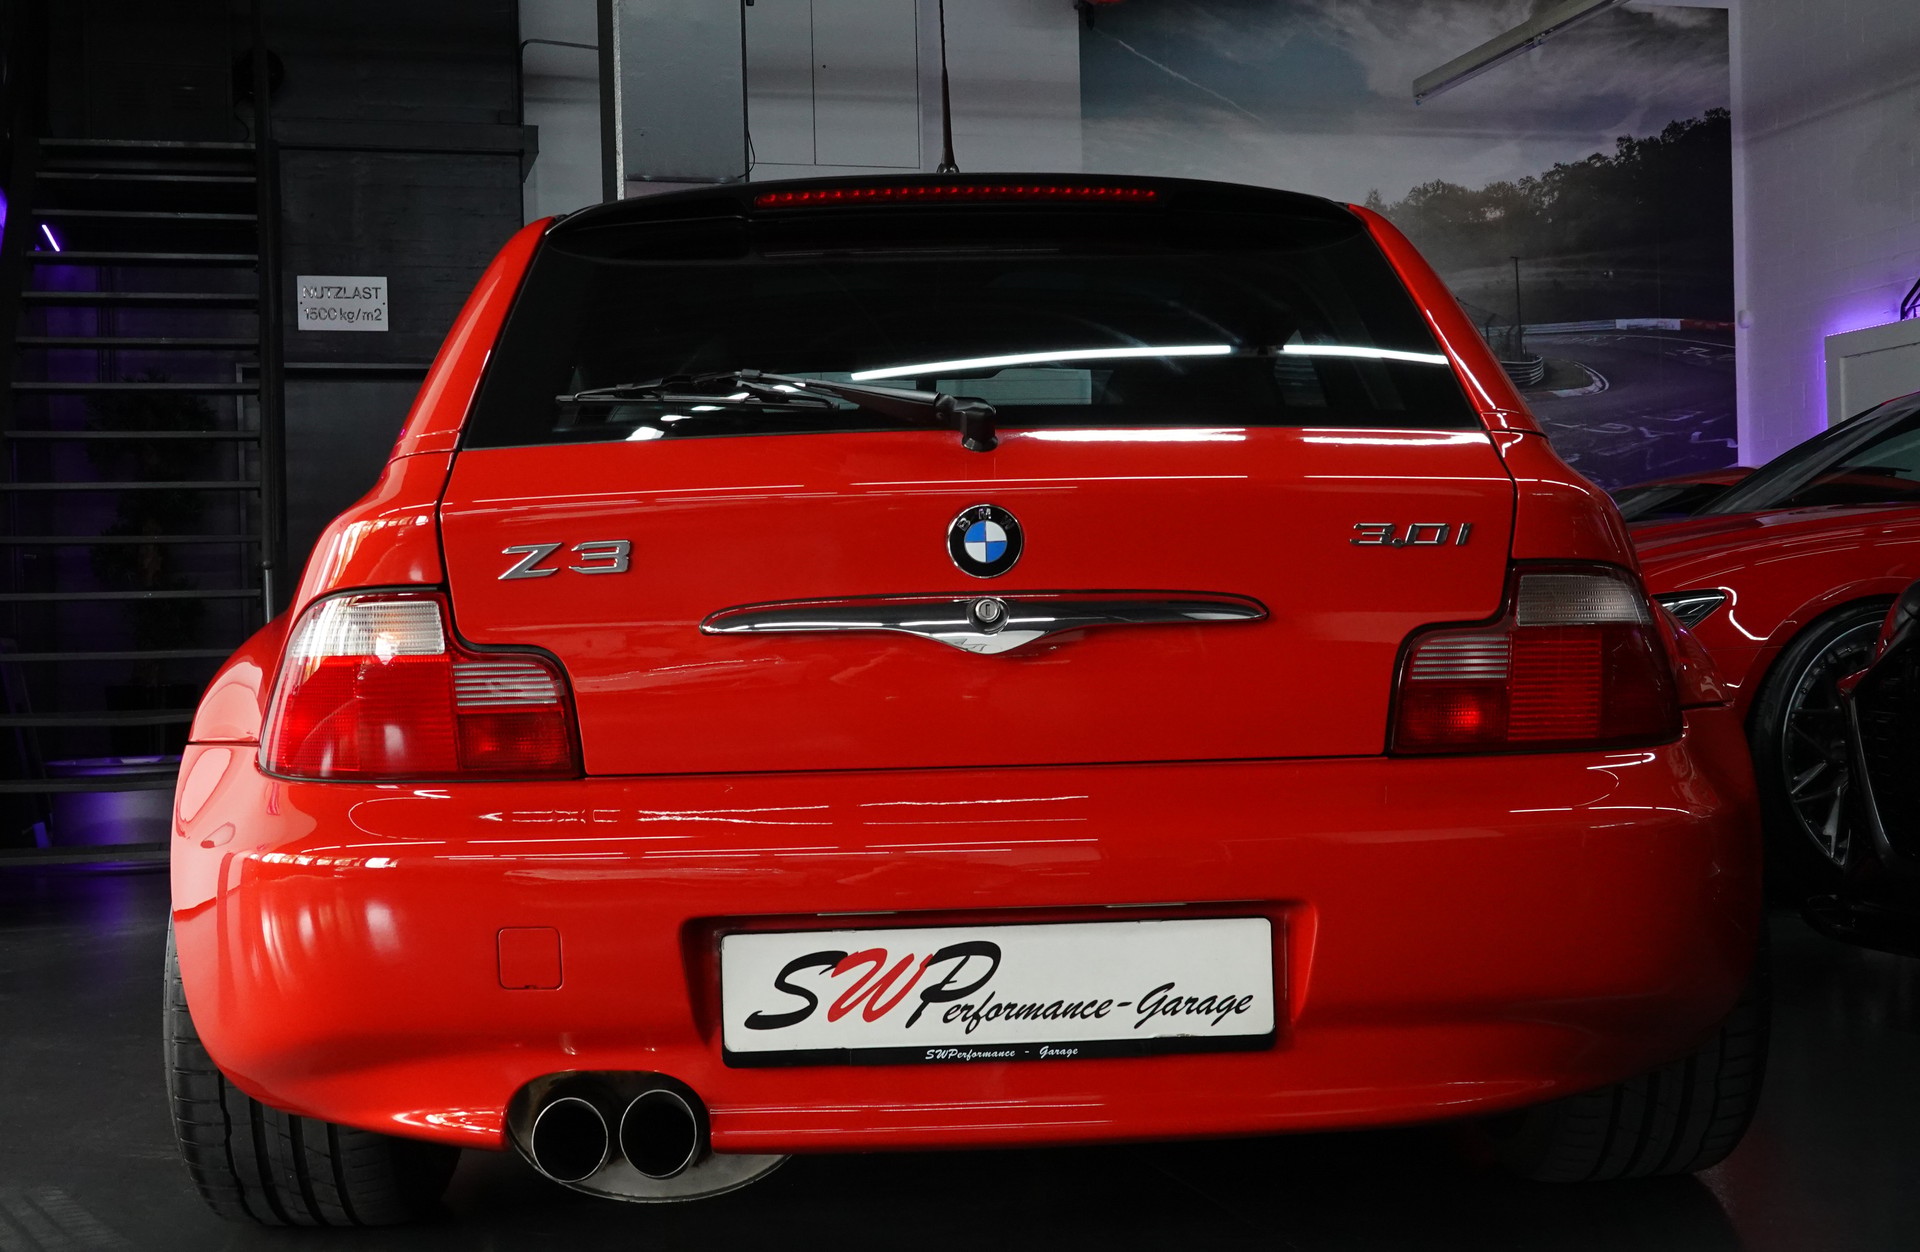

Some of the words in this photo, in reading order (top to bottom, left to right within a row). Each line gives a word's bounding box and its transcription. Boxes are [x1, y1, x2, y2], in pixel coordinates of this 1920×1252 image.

[303, 286, 381, 299] NUTZLAST
[304, 307, 337, 320] 1500
[957, 508, 1014, 531] BMW
[498, 540, 630, 580] Z3
[925, 1049, 1016, 1061] SWPerformance
[1039, 1045, 1078, 1059] Garage
